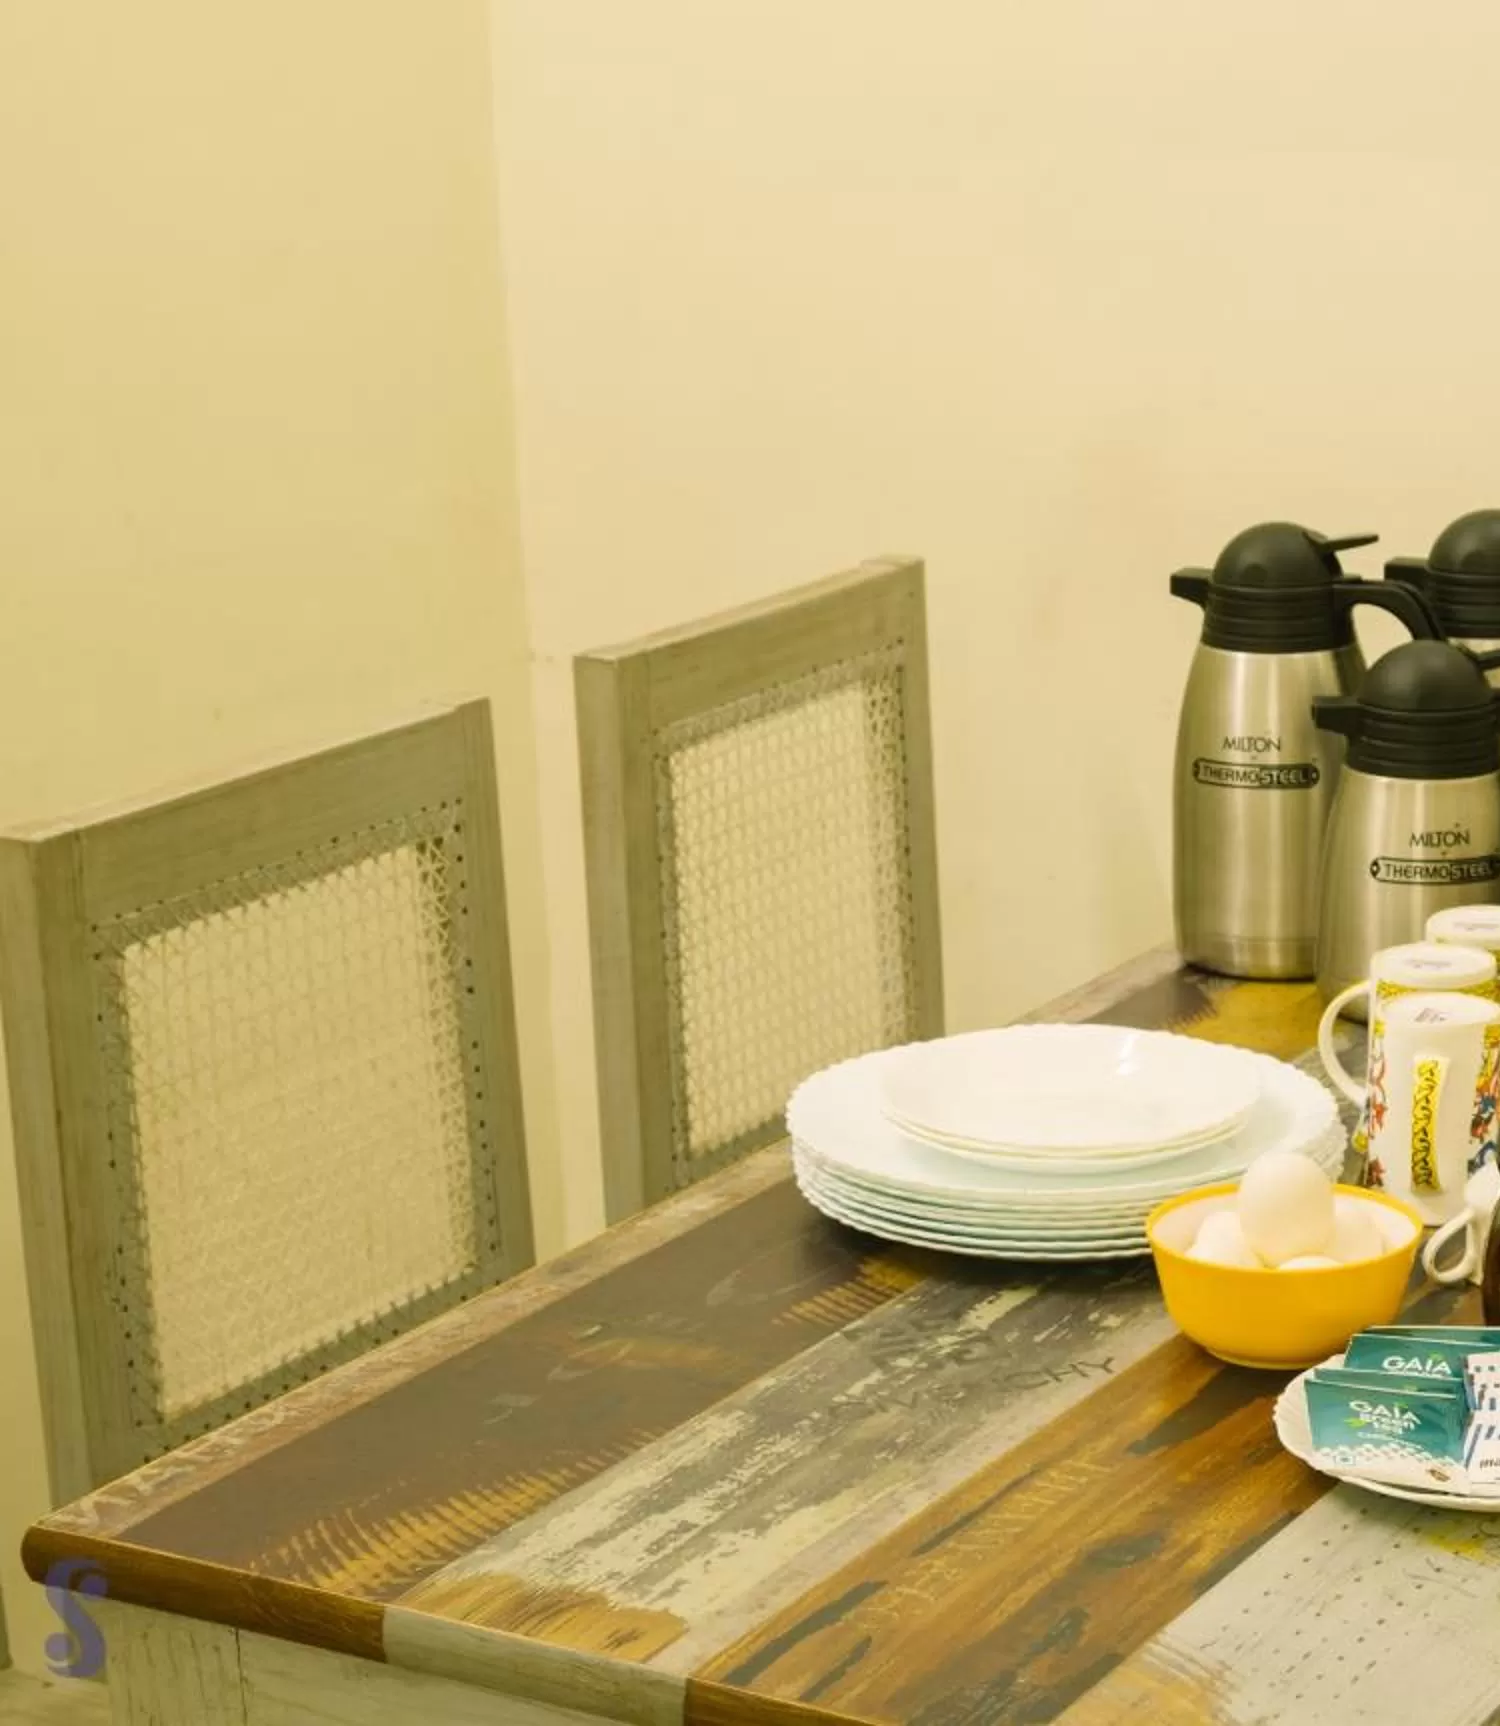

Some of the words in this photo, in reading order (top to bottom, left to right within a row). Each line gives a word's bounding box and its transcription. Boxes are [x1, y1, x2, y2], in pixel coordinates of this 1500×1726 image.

[1222, 735, 1281, 753] MILTON
[1202, 763, 1310, 784] THERMOSTEEL
[1408, 830, 1471, 849] MILTON
[1384, 861, 1495, 881] THERMOSTEEL
[1382, 1354, 1453, 1376] GAIA
[1349, 1400, 1422, 1425] GAIA
